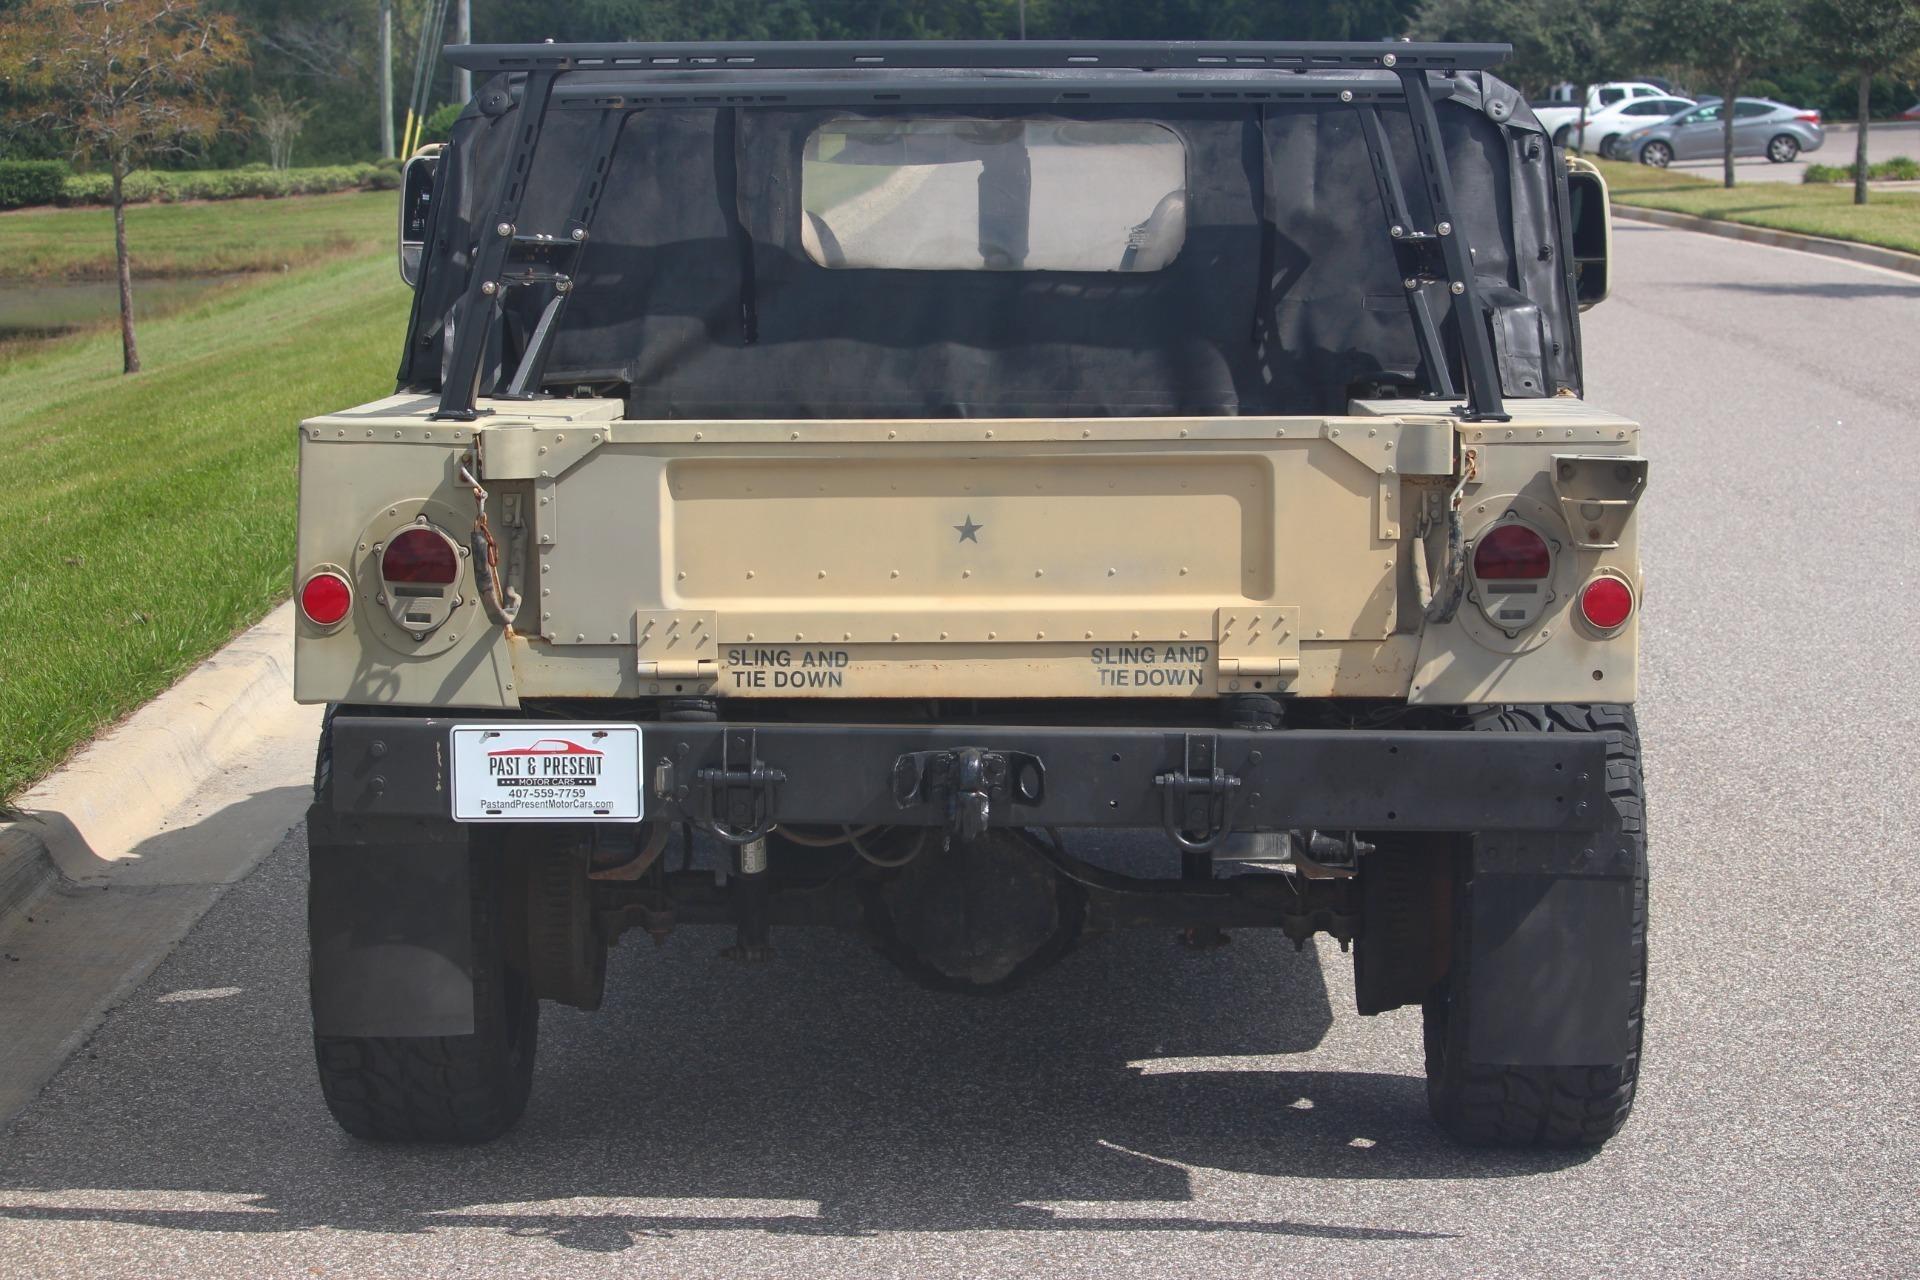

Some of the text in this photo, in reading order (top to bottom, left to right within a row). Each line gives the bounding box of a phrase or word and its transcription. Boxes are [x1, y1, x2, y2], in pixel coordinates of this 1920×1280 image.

[727, 649, 849, 668] SLING AND
[1090, 646, 1209, 665] SLING AND
[732, 671, 843, 688] TIE DOWN
[1097, 667, 1203, 686] TIE DOWN
[489, 756, 603, 776] PAST & PRESENT
[518, 778, 576, 786] MOTOR CARS
[508, 788, 586, 798] 407-559-7759
[480, 799, 614, 809] PastandPresentMotorCars.com
